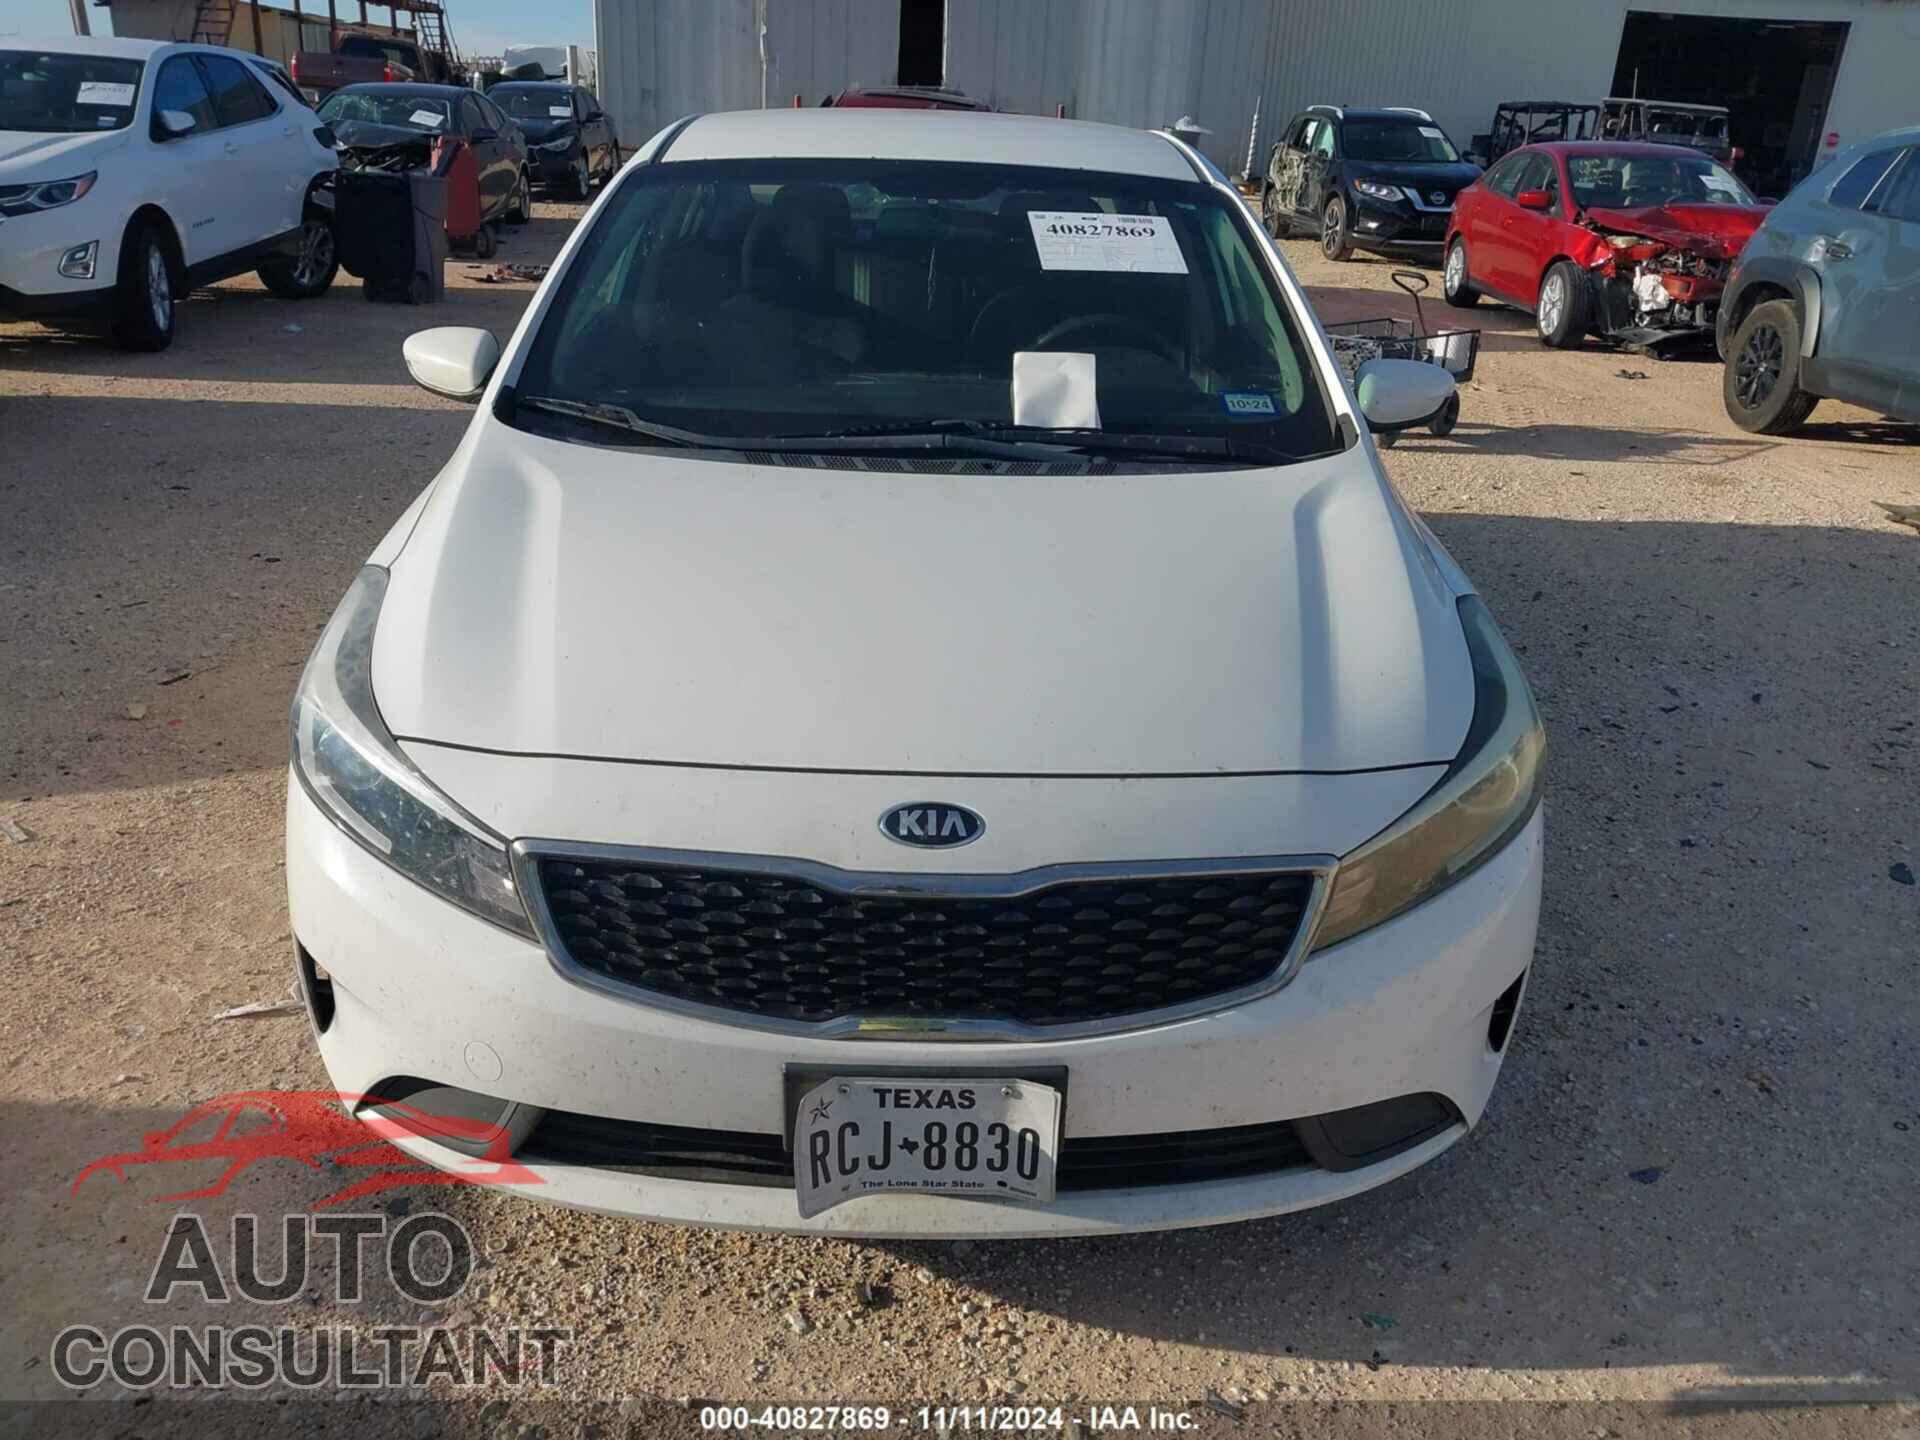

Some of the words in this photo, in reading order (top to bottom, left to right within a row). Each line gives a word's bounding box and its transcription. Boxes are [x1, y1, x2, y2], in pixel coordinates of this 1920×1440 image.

[1045, 223, 1156, 238] 40827869
[898, 809, 967, 837] KIA
[873, 1088, 976, 1109] TEXAS
[861, 1180, 884, 1189] The
[887, 1179, 918, 1188] Lone
[921, 1179, 947, 1188] Star
